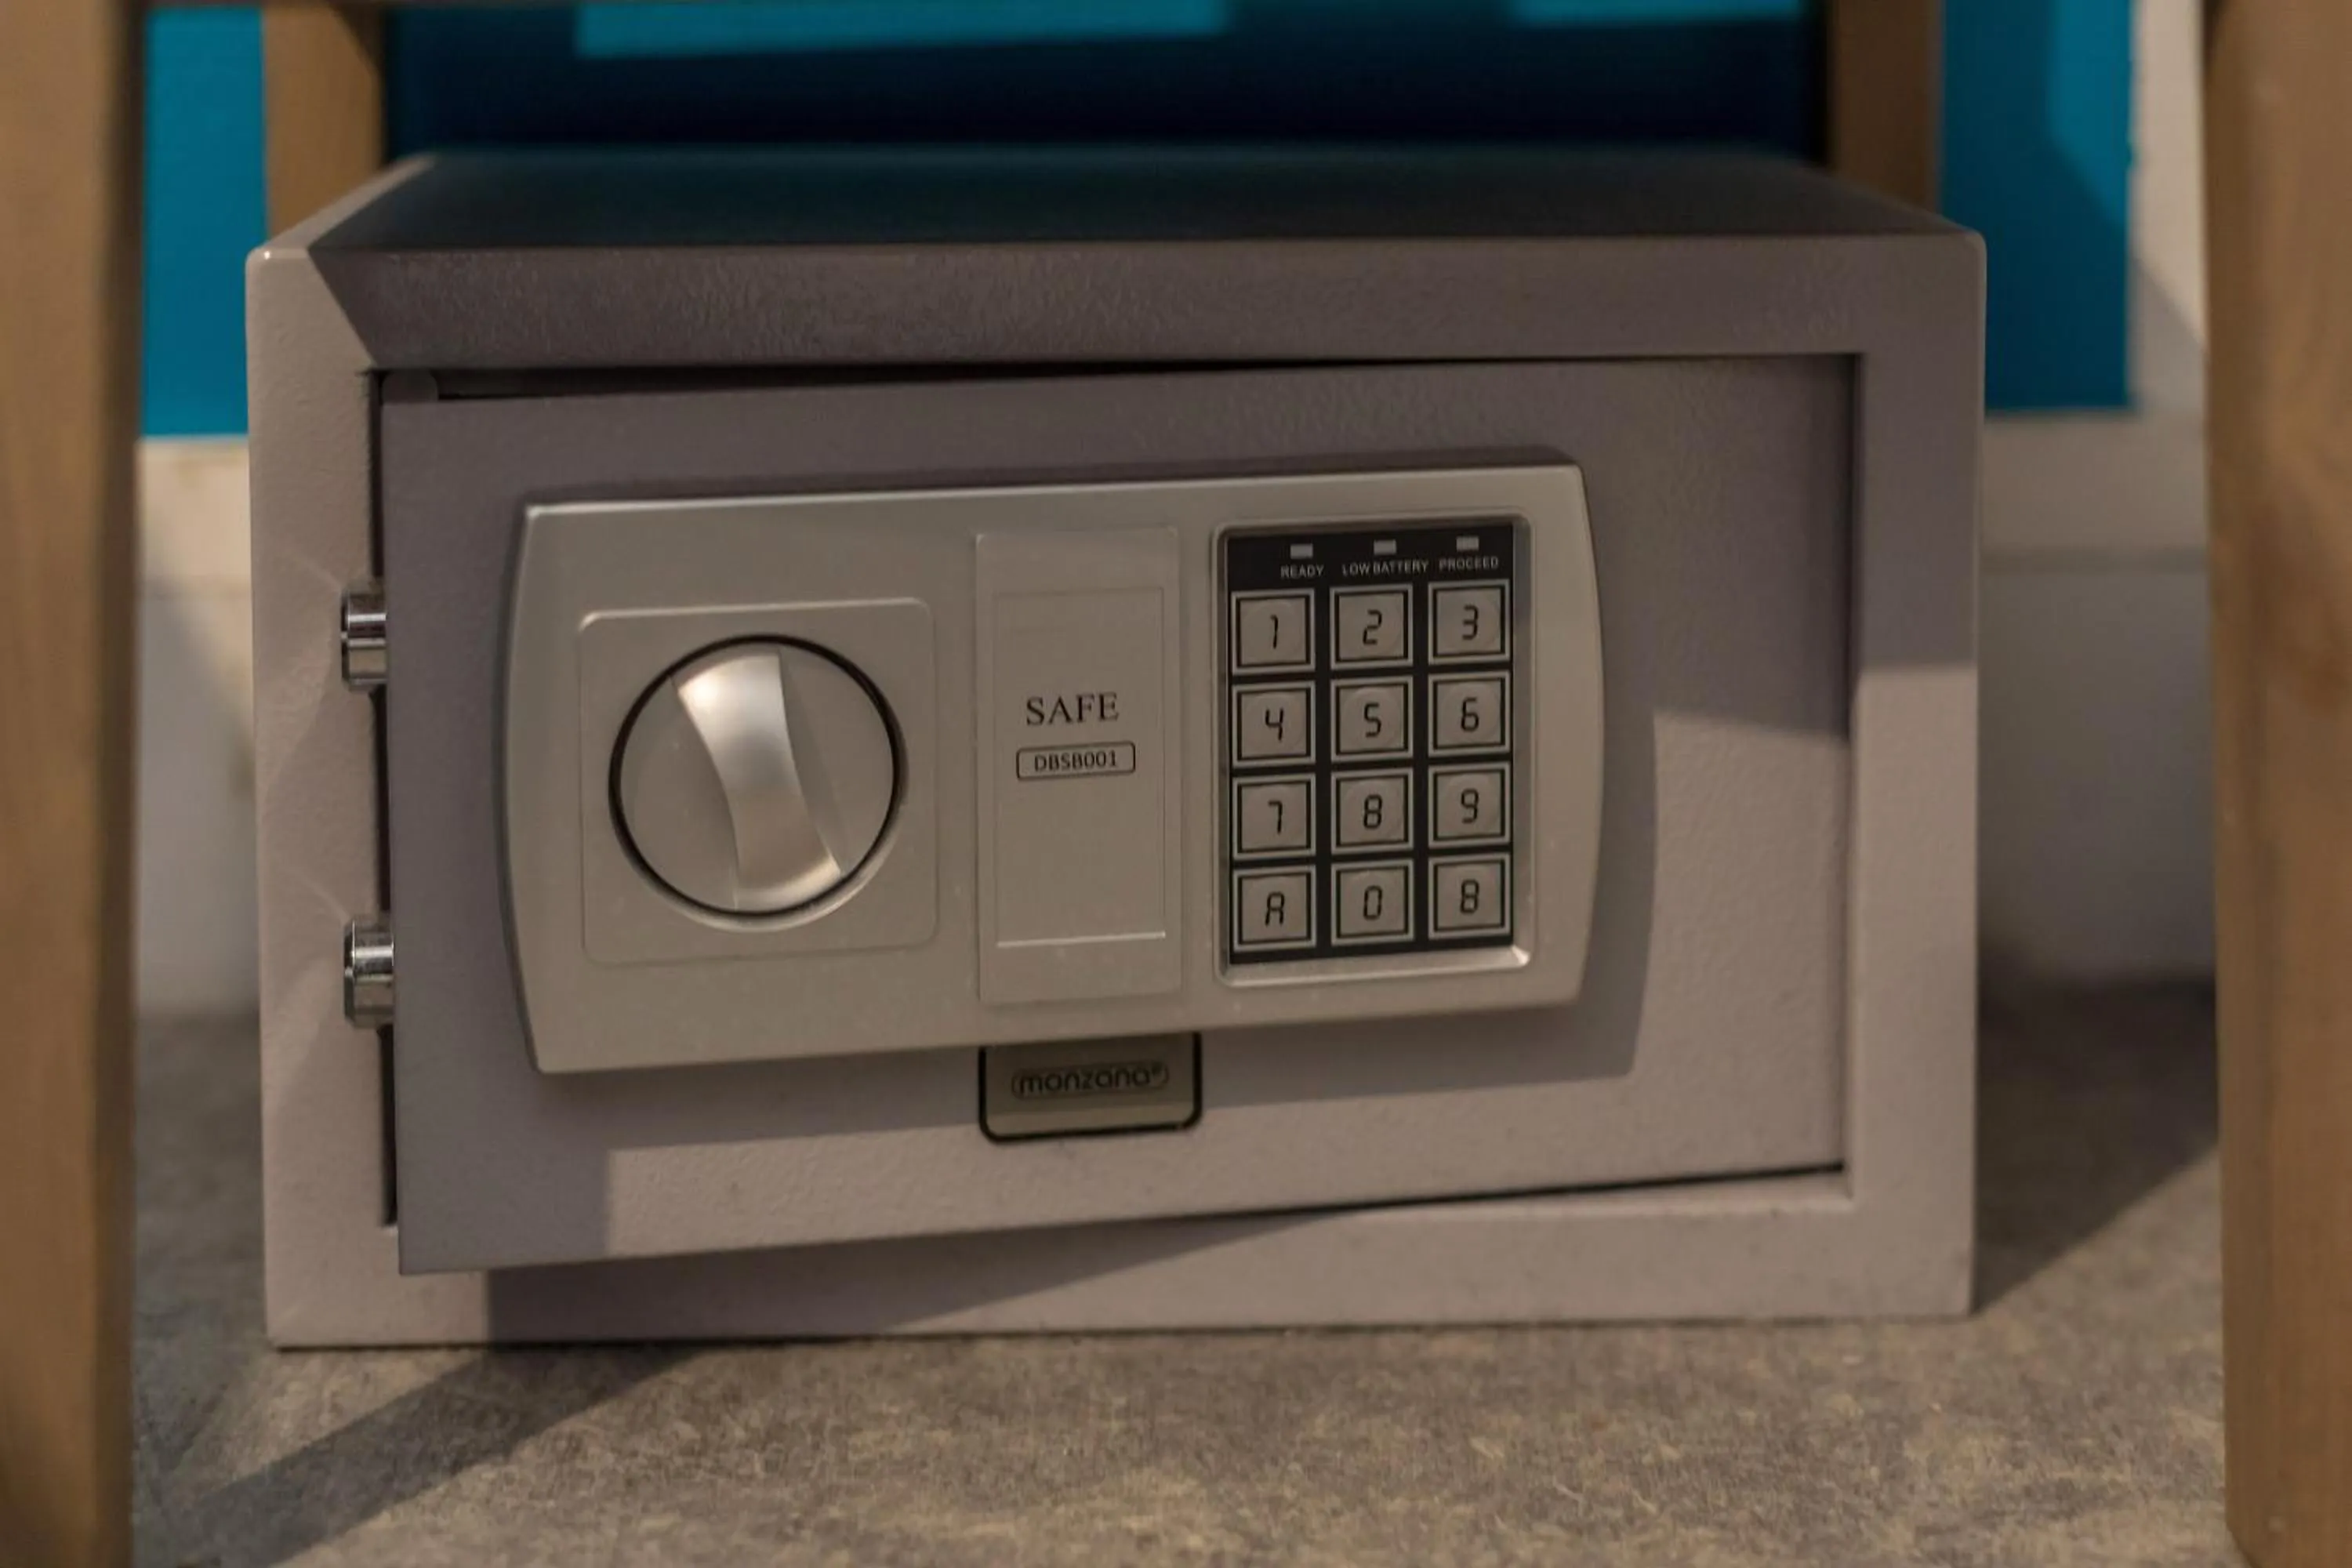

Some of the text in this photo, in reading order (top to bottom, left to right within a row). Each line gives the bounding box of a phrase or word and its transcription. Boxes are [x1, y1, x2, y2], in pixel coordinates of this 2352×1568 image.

[1280, 564, 1324, 579] READY
[1341, 559, 1429, 577] LOW BATTERY
[1439, 556, 1499, 571] PROCEED
[1269, 614, 1279, 649] 1
[1363, 609, 1382, 645] 2
[1461, 604, 1479, 641] 3
[1025, 691, 1120, 726] SAFE
[1265, 708, 1284, 741] 4
[1363, 702, 1382, 738] 5
[1460, 697, 1479, 733] 6
[1267, 800, 1283, 834] 7
[1363, 793, 1383, 829] 8
[1460, 789, 1479, 824] 9
[1363, 885, 1383, 920] 0
